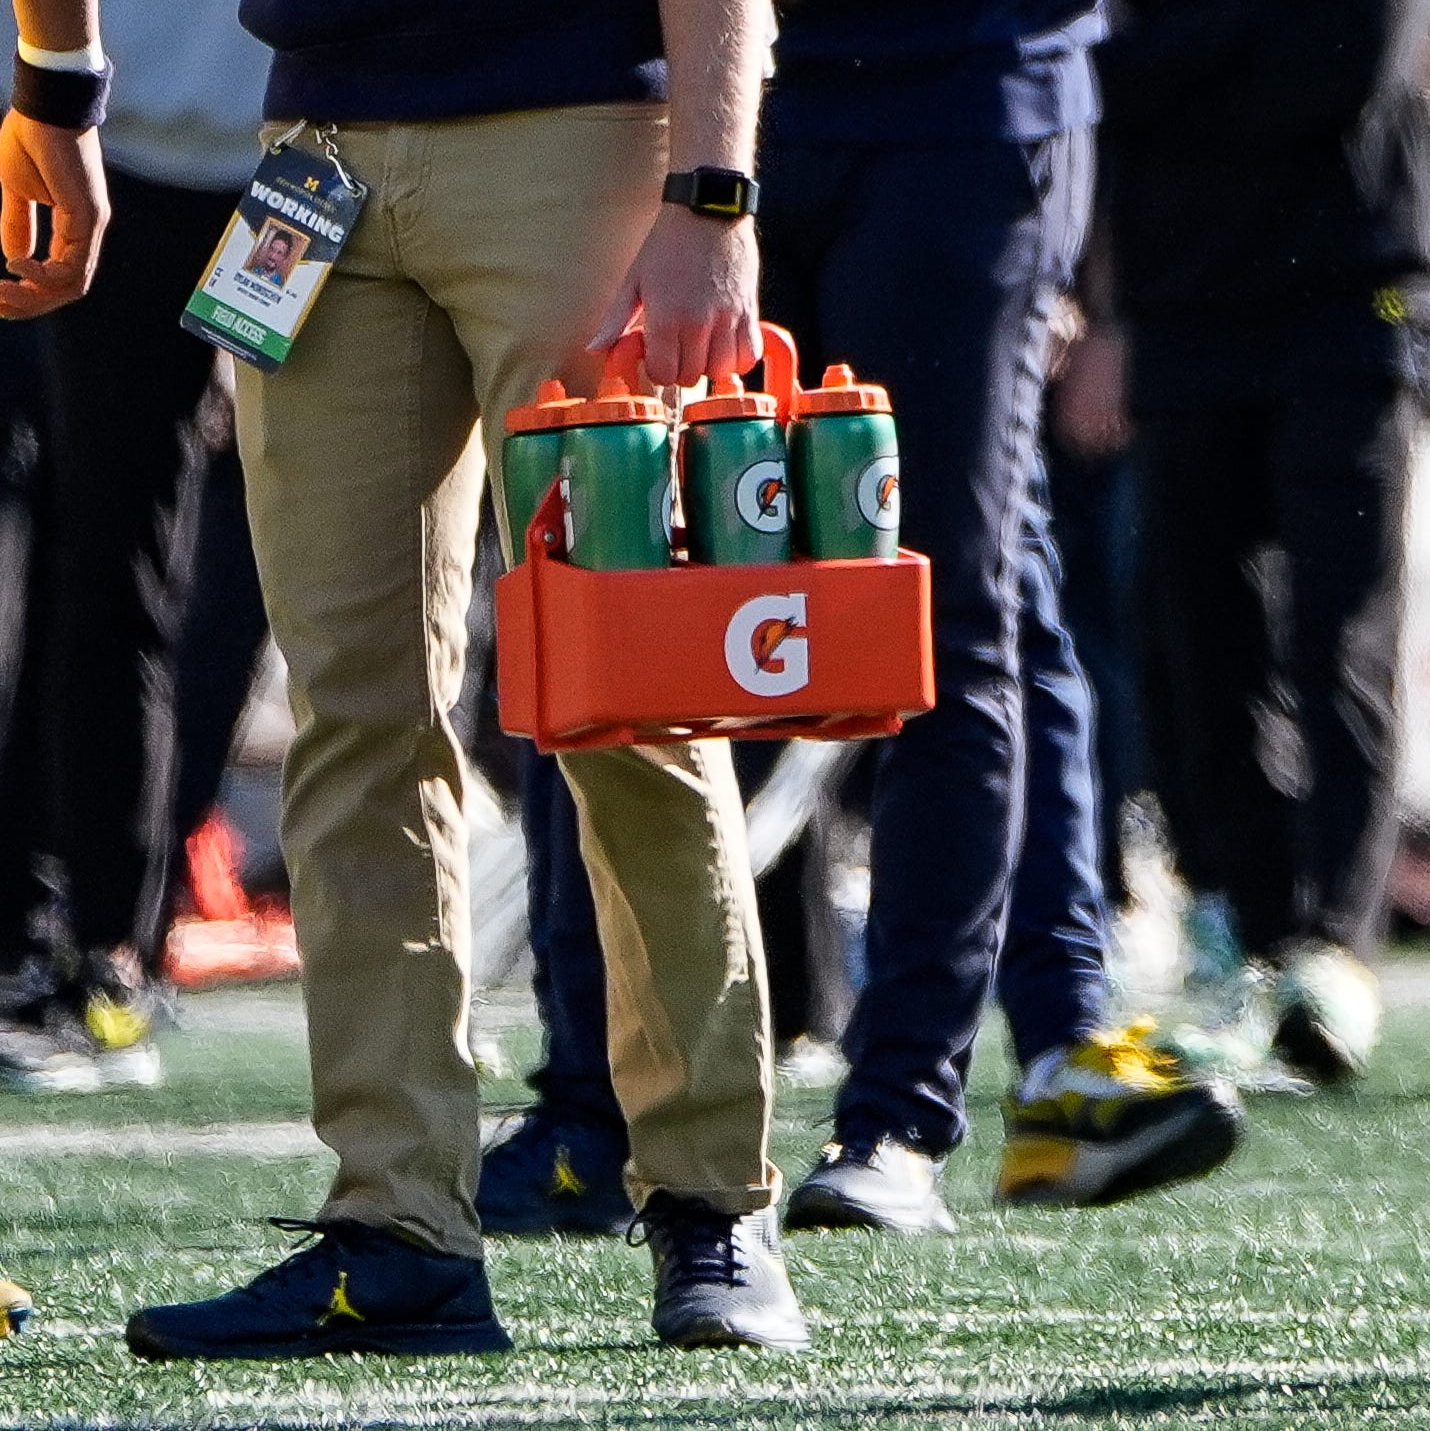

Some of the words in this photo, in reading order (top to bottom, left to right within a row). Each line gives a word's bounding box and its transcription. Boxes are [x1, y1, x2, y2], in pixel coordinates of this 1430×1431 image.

[251, 181, 345, 244] WORKING
[735, 460, 788, 533] G
[724, 592, 810, 697] G
